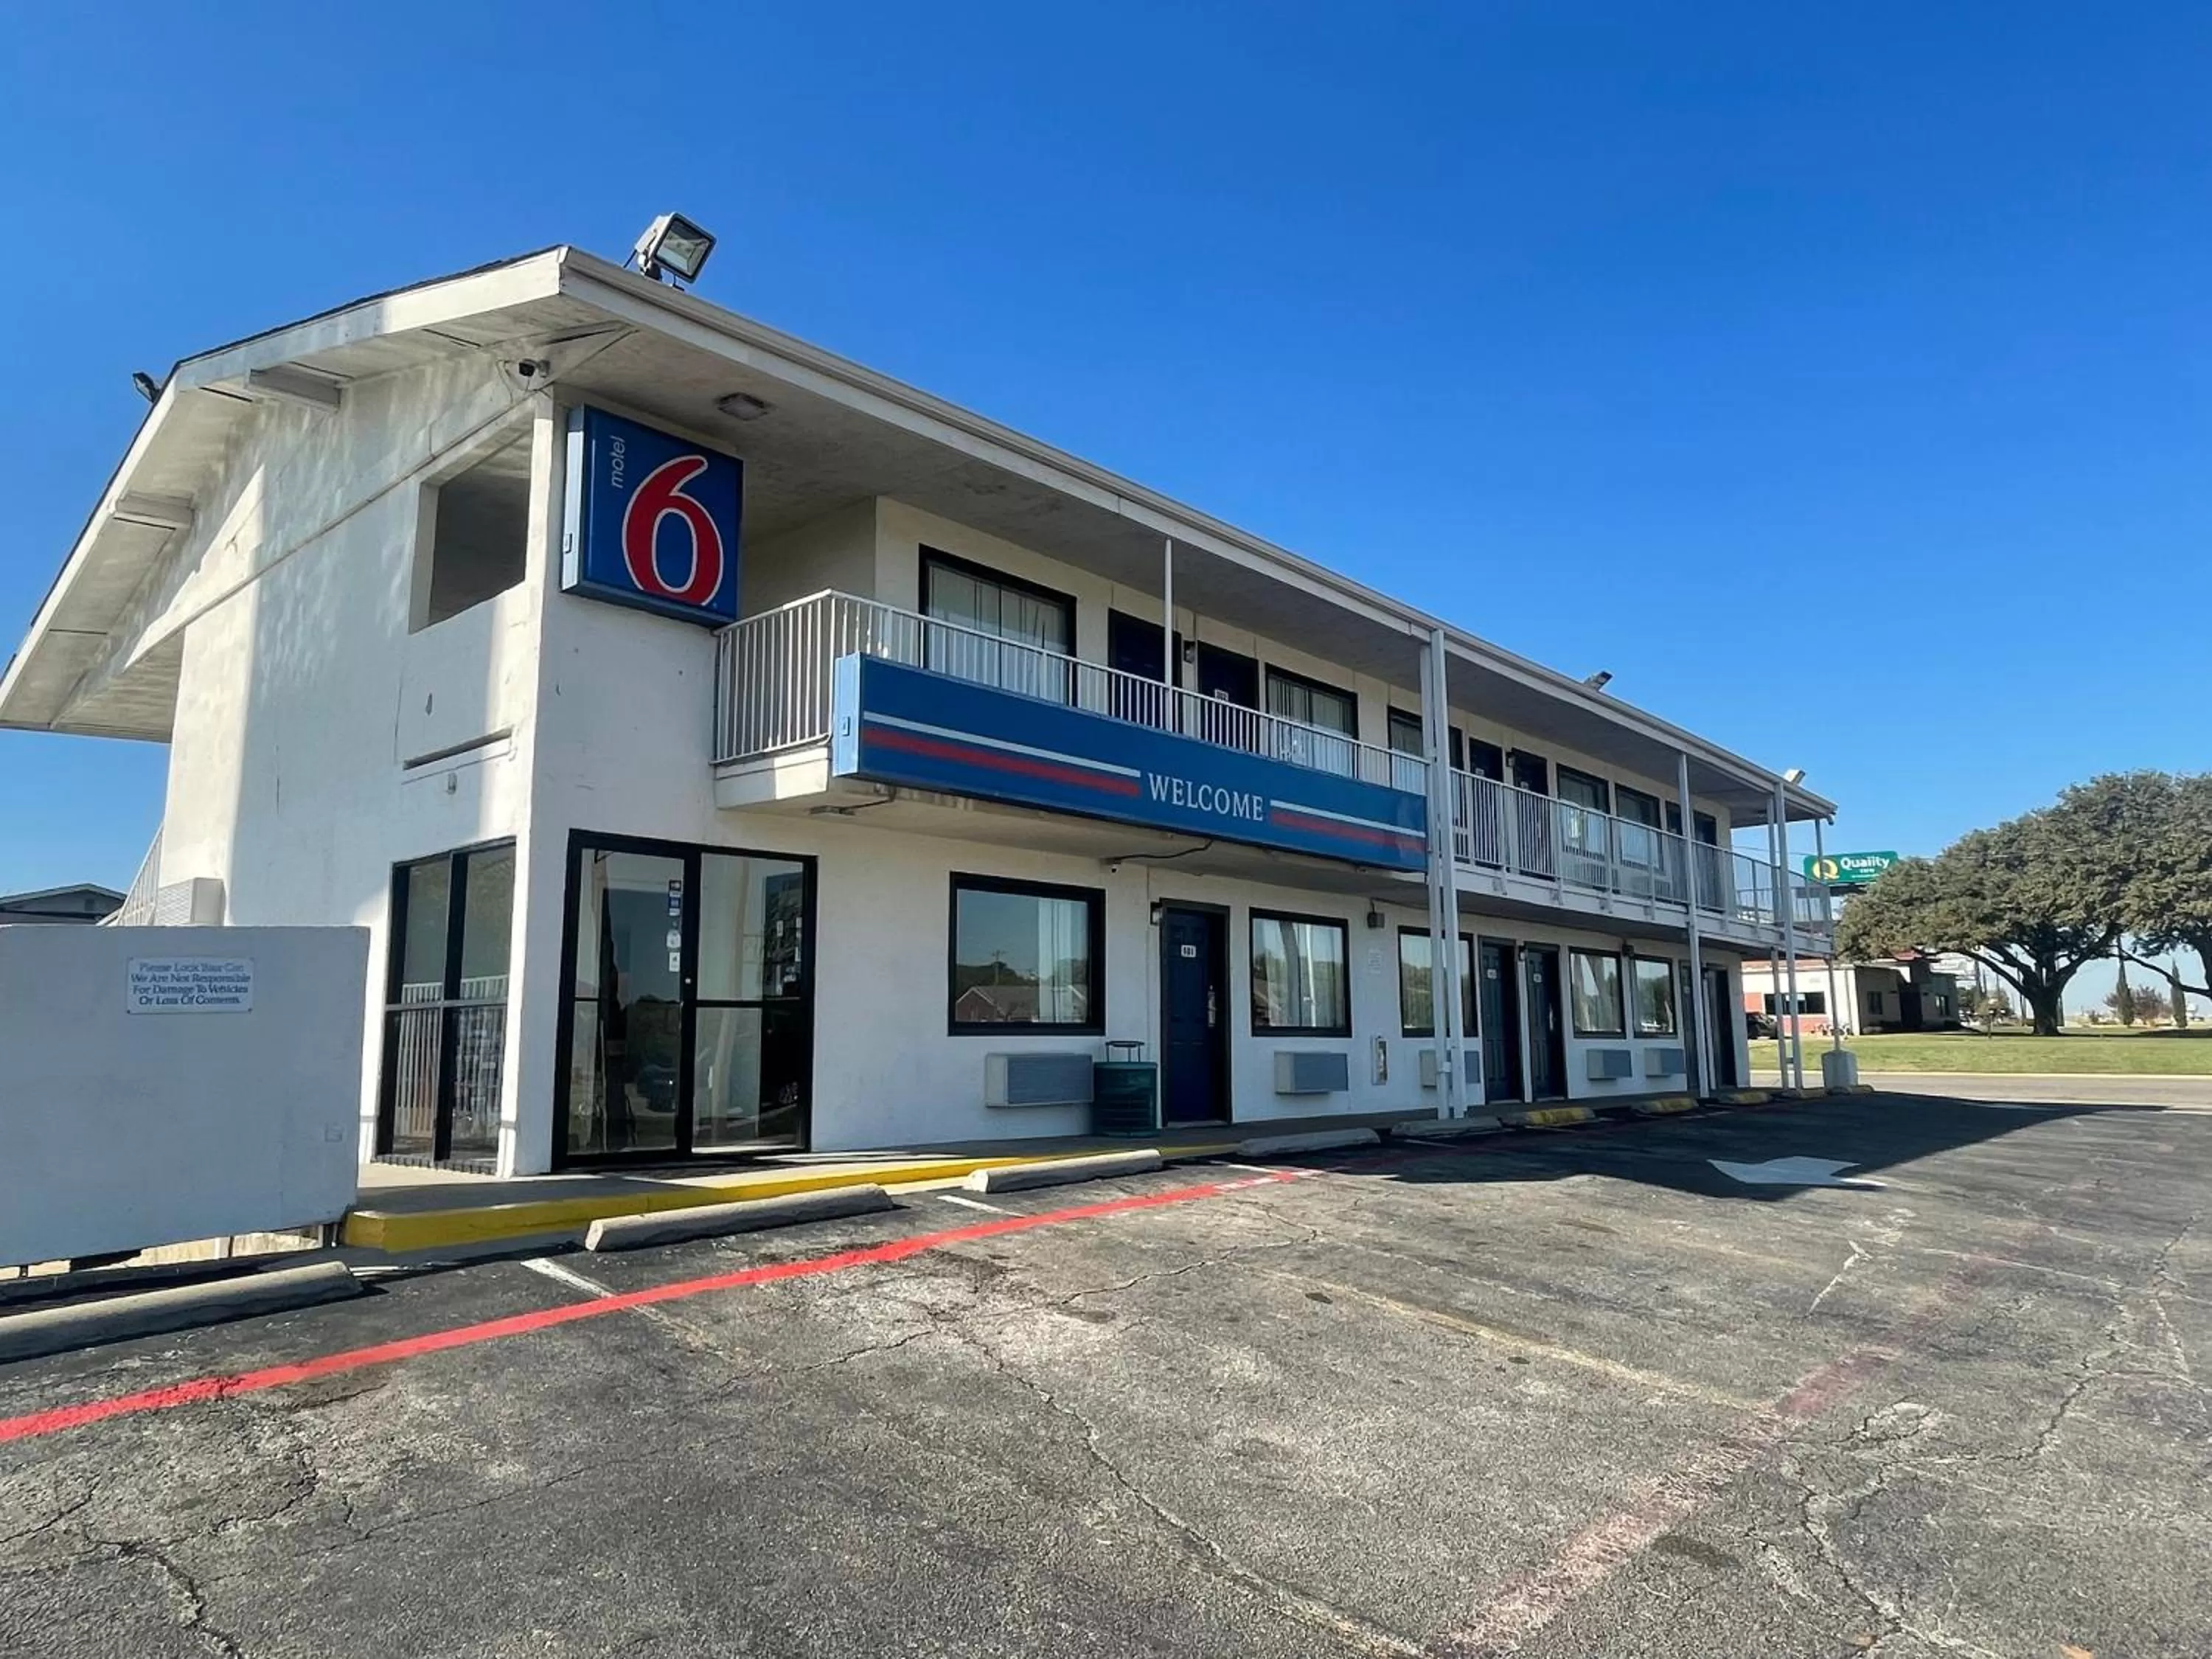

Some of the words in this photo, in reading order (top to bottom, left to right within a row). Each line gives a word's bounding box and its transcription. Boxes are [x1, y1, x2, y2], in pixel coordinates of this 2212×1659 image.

[609, 435, 626, 490] motel
[622, 454, 724, 606] 6
[1147, 772, 1263, 821] WELCOME
[1840, 856, 1890, 871] Quality
[131, 973, 148, 982] We
[149, 973, 169, 983] Are
[170, 973, 189, 982] Not
[191, 973, 251, 984] Responsible
[133, 984, 152, 994] For
[153, 984, 195, 995] Damage
[195, 984, 207, 993] To
[208, 984, 248, 993] Vehicles
[139, 995, 154, 1005] Or
[156, 995, 179, 1005] Loss
[180, 995, 195, 1005] Of
